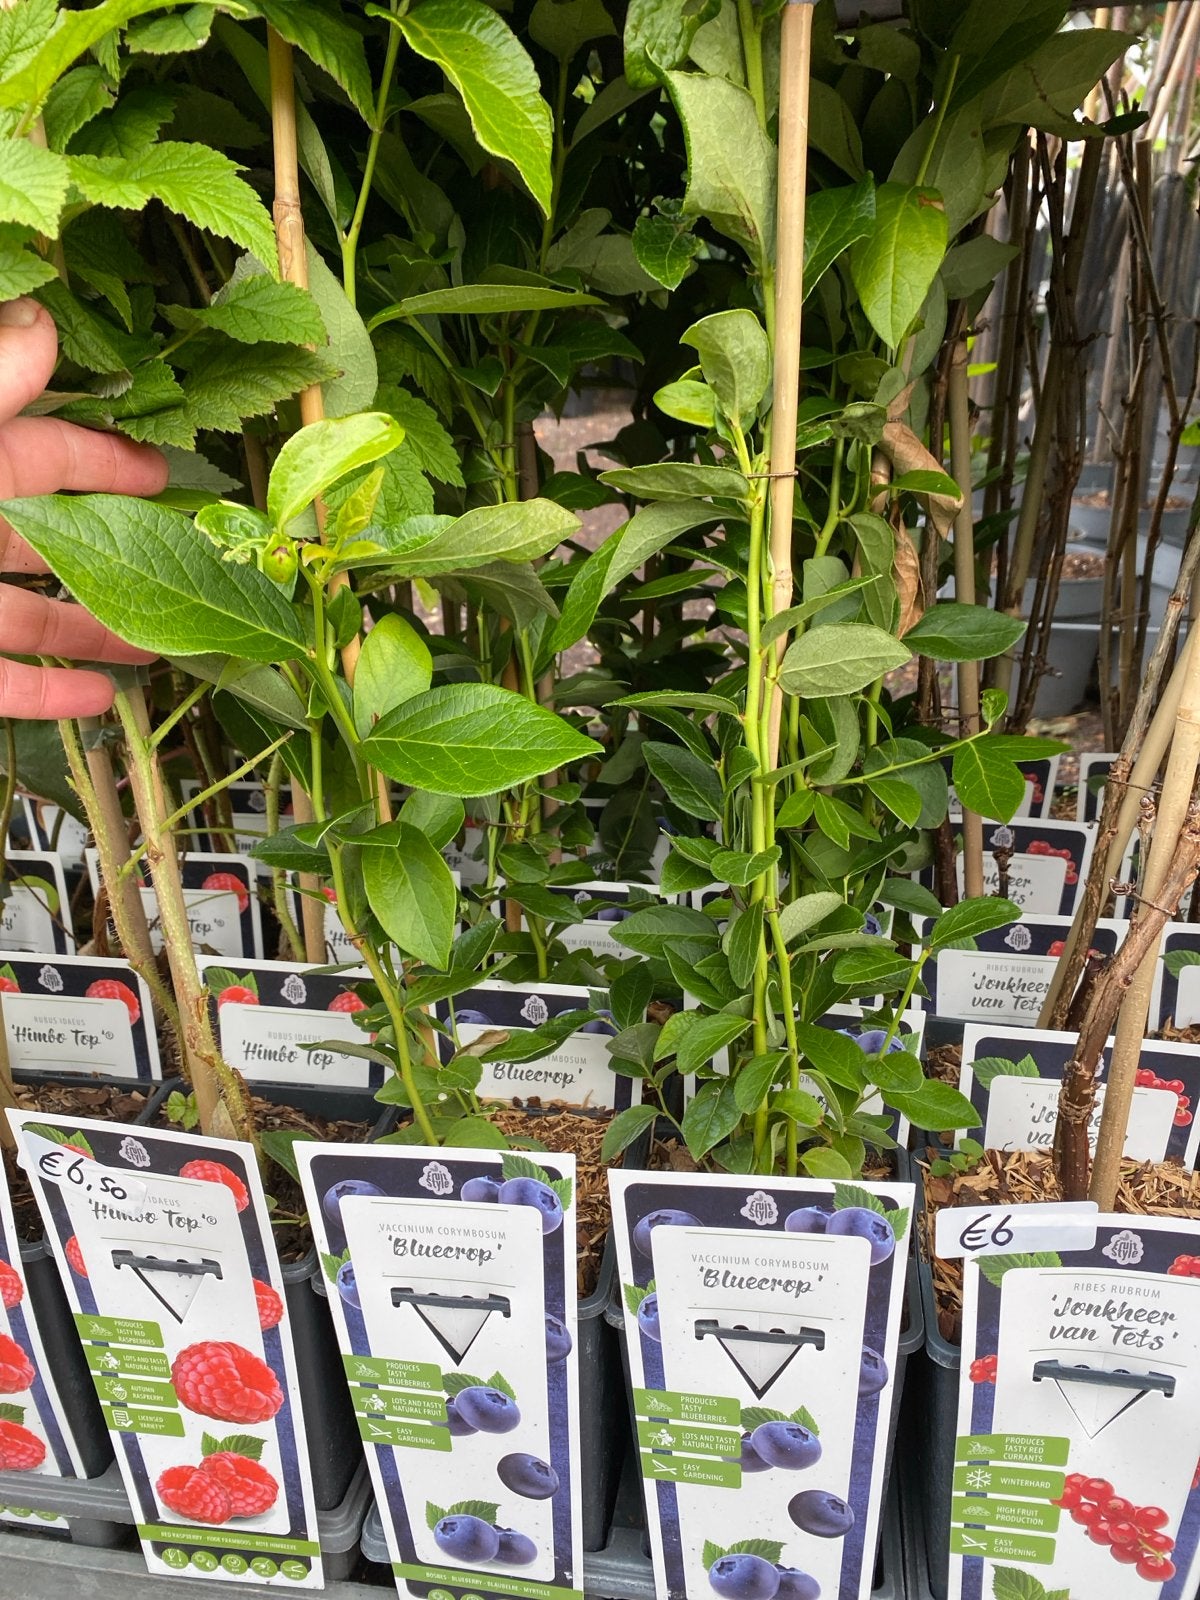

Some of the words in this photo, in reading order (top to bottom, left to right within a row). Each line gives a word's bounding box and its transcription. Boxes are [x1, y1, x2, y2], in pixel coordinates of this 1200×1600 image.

[986, 963, 1009, 972] RIBES
[1011, 965, 1044, 974] RUBRUM
[971, 996, 1006, 1009] van
[33, 1015, 58, 1024] RUBUS
[60, 1017, 87, 1026] IDAEUS
[11, 1024, 67, 1044] 'Himbo
[267, 1031, 293, 1041] RUBUS
[295, 1033, 322, 1042] IDAEUS
[241, 1039, 298, 1063] 'Himbo
[540, 1054, 587, 1065] YMBOSUM
[490, 1062, 583, 1088] 'Bluecrop'
[1027, 1130, 1055, 1145] va
[148, 1196, 182, 1208] IDAEUS
[379, 1223, 434, 1234] VACCINIUM
[437, 1226, 507, 1240] CORYMBOSUM
[959, 1213, 1014, 1251] €6
[388, 1234, 502, 1266] 'Bluecrop'
[691, 1253, 750, 1265] VACCINIUM
[754, 1257, 830, 1272] CORYMBOSUM
[699, 1265, 823, 1298] 'Bluecrop'
[1073, 1282, 1106, 1293] RIBES
[1110, 1285, 1161, 1299] RUBRUM
[1051, 1293, 1178, 1326] 'Jonkheer
[114, 1320, 144, 1329] PRODUCES
[116, 1328, 133, 1336] TASTY
[134, 1329, 146, 1337] RED
[1049, 1324, 1100, 1341] van
[1111, 1323, 1179, 1351] Tets'
[118, 1336, 156, 1346] RASPBERRIES
[123, 1354, 137, 1362] LOTS
[150, 1357, 167, 1365] TASTY
[125, 1362, 151, 1371] NATURAL
[151, 1365, 167, 1373] FRUIT
[386, 1361, 420, 1372] PRODUCES
[387, 1369, 407, 1378] TASTY
[131, 1385, 155, 1393] AUTUMN
[388, 1378, 431, 1389] BLUEBERRIES
[133, 1392, 164, 1402] RASPBERRY
[680, 1395, 718, 1407] PRODUCES
[407, 1399, 422, 1407] AND
[422, 1401, 442, 1409] TASTY
[681, 1403, 702, 1412] TASTY
[392, 1404, 421, 1414] NATURAL
[423, 1407, 442, 1416] FRUIT
[138, 1415, 164, 1423] LICENSED
[681, 1412, 727, 1424] BLUEBERRIES
[397, 1427, 413, 1435] EASY
[398, 1434, 436, 1445] GARDENING
[699, 1434, 715, 1442] AND
[715, 1436, 737, 1444] TASTY
[1005, 1436, 1045, 1446] PRODUCES
[682, 1440, 714, 1450] NATURAL
[715, 1443, 736, 1452] FRUIT
[1004, 1444, 1027, 1453] TASTY
[1028, 1446, 1044, 1454] RED
[1003, 1452, 1043, 1463] CURRANTS
[683, 1463, 700, 1471] EASY
[683, 1470, 724, 1482] GARDENING
[1000, 1476, 1051, 1489] WINTERHARD
[996, 1506, 1016, 1515] HIGH
[1016, 1508, 1038, 1517] FRUIT
[996, 1514, 1044, 1526] PRODUCTION
[994, 1538, 1013, 1547] EASY
[993, 1546, 1037, 1558] GARDENING
